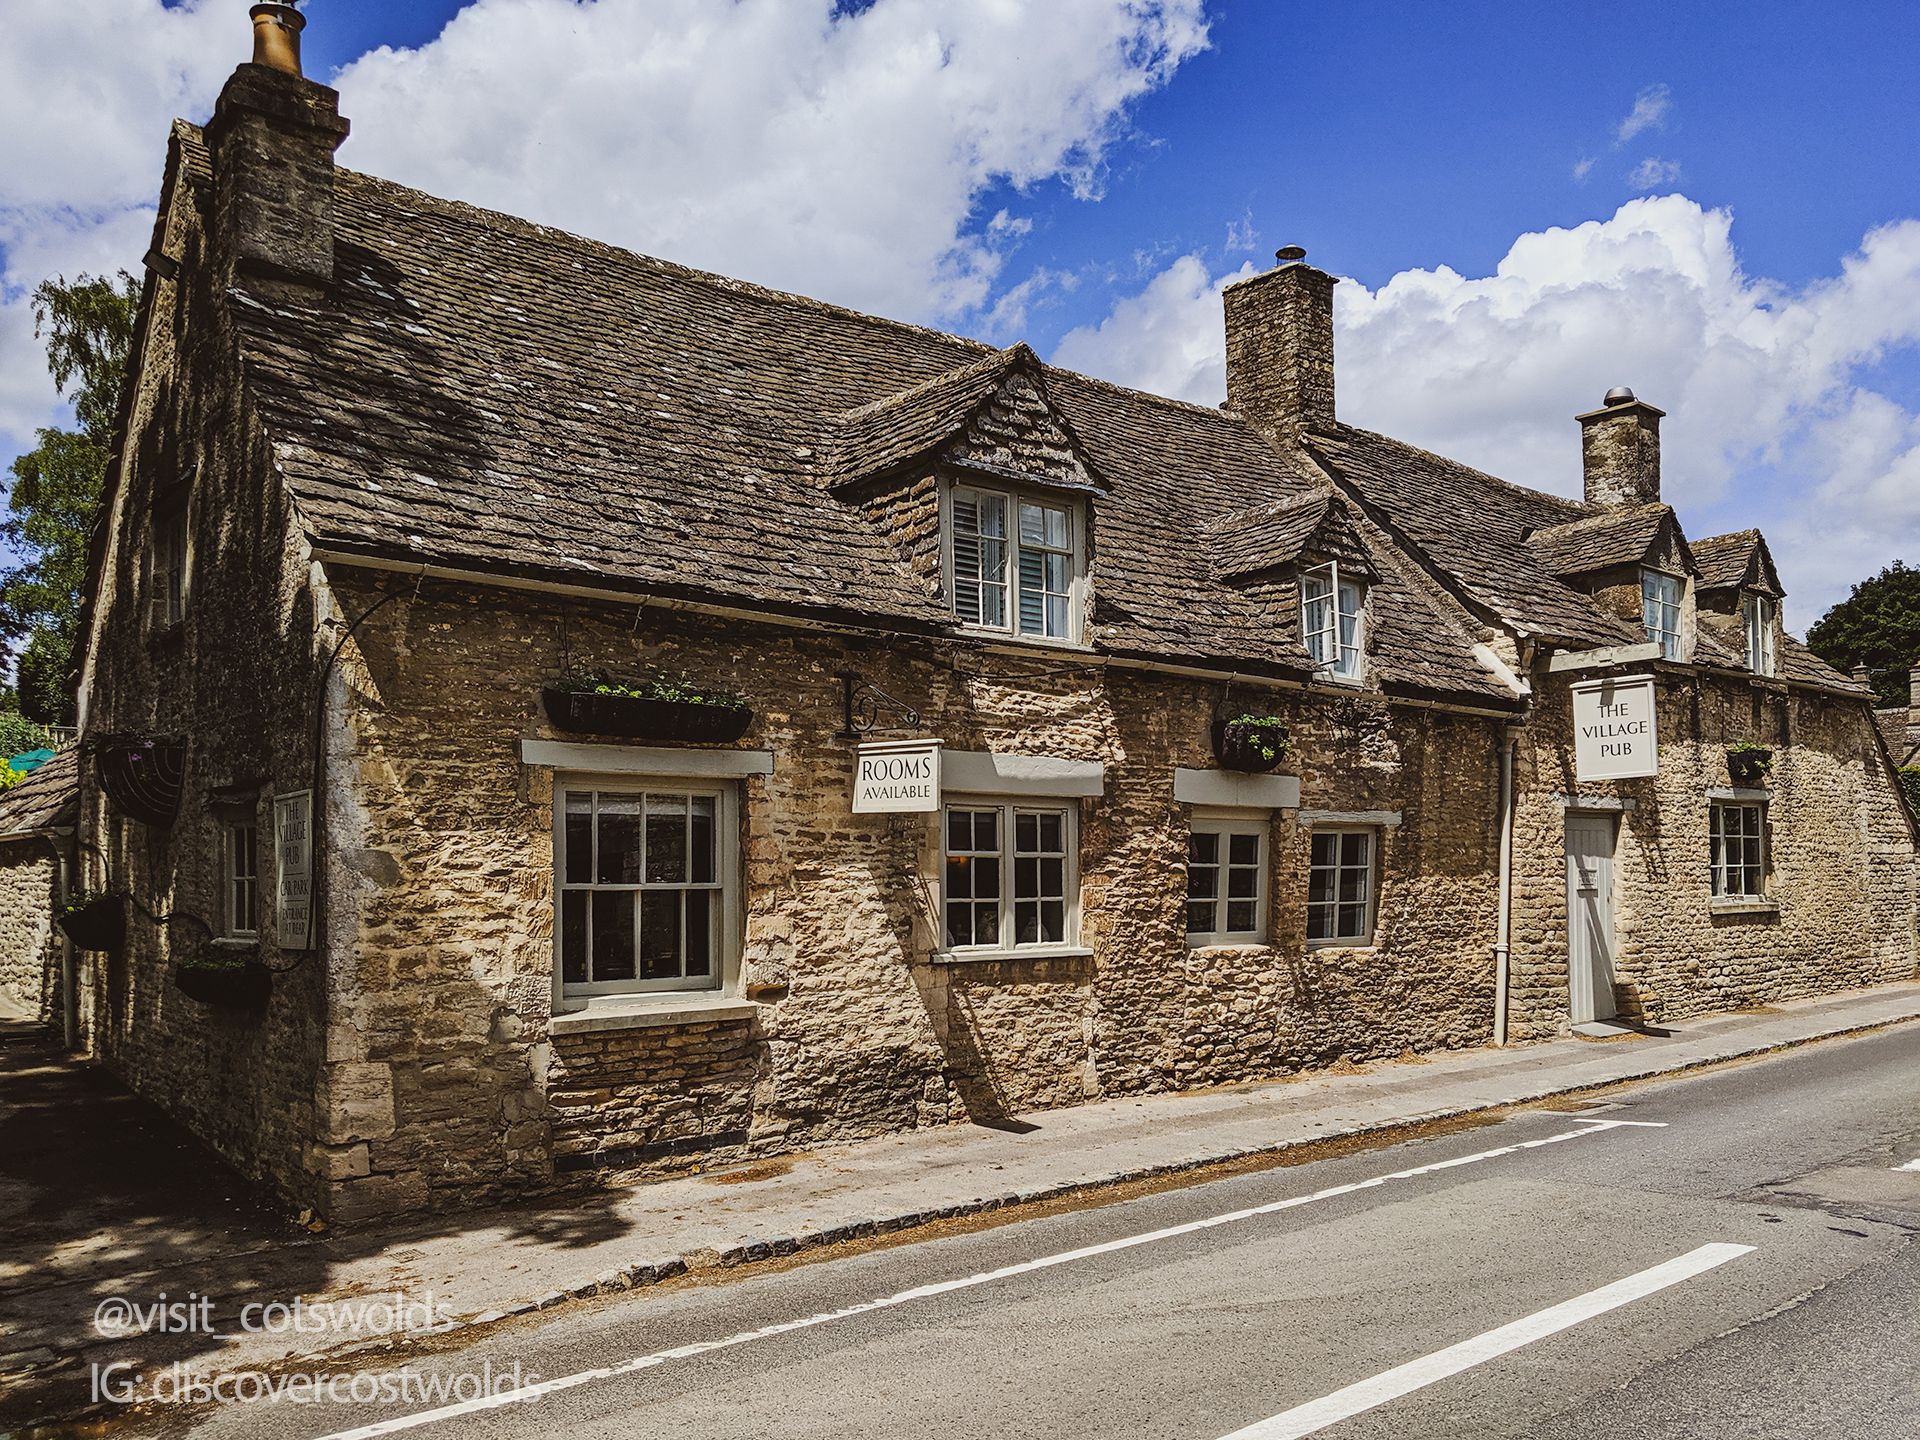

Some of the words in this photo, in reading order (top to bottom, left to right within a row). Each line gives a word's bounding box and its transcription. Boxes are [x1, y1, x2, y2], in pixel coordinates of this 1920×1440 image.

[1597, 703, 1629, 718] THE
[1582, 720, 1648, 739] VILLAGE
[1601, 742, 1632, 758] PUB
[863, 757, 931, 781] ROOMS
[863, 784, 930, 800] AVAILABLE
[283, 802, 299, 821] THE
[279, 820, 306, 843] VILLAGE
[286, 845, 300, 866] PUB
[280, 880, 292, 897] CAR
[293, 879, 309, 896] PARK
[282, 907, 308, 921] ENTRANCE
